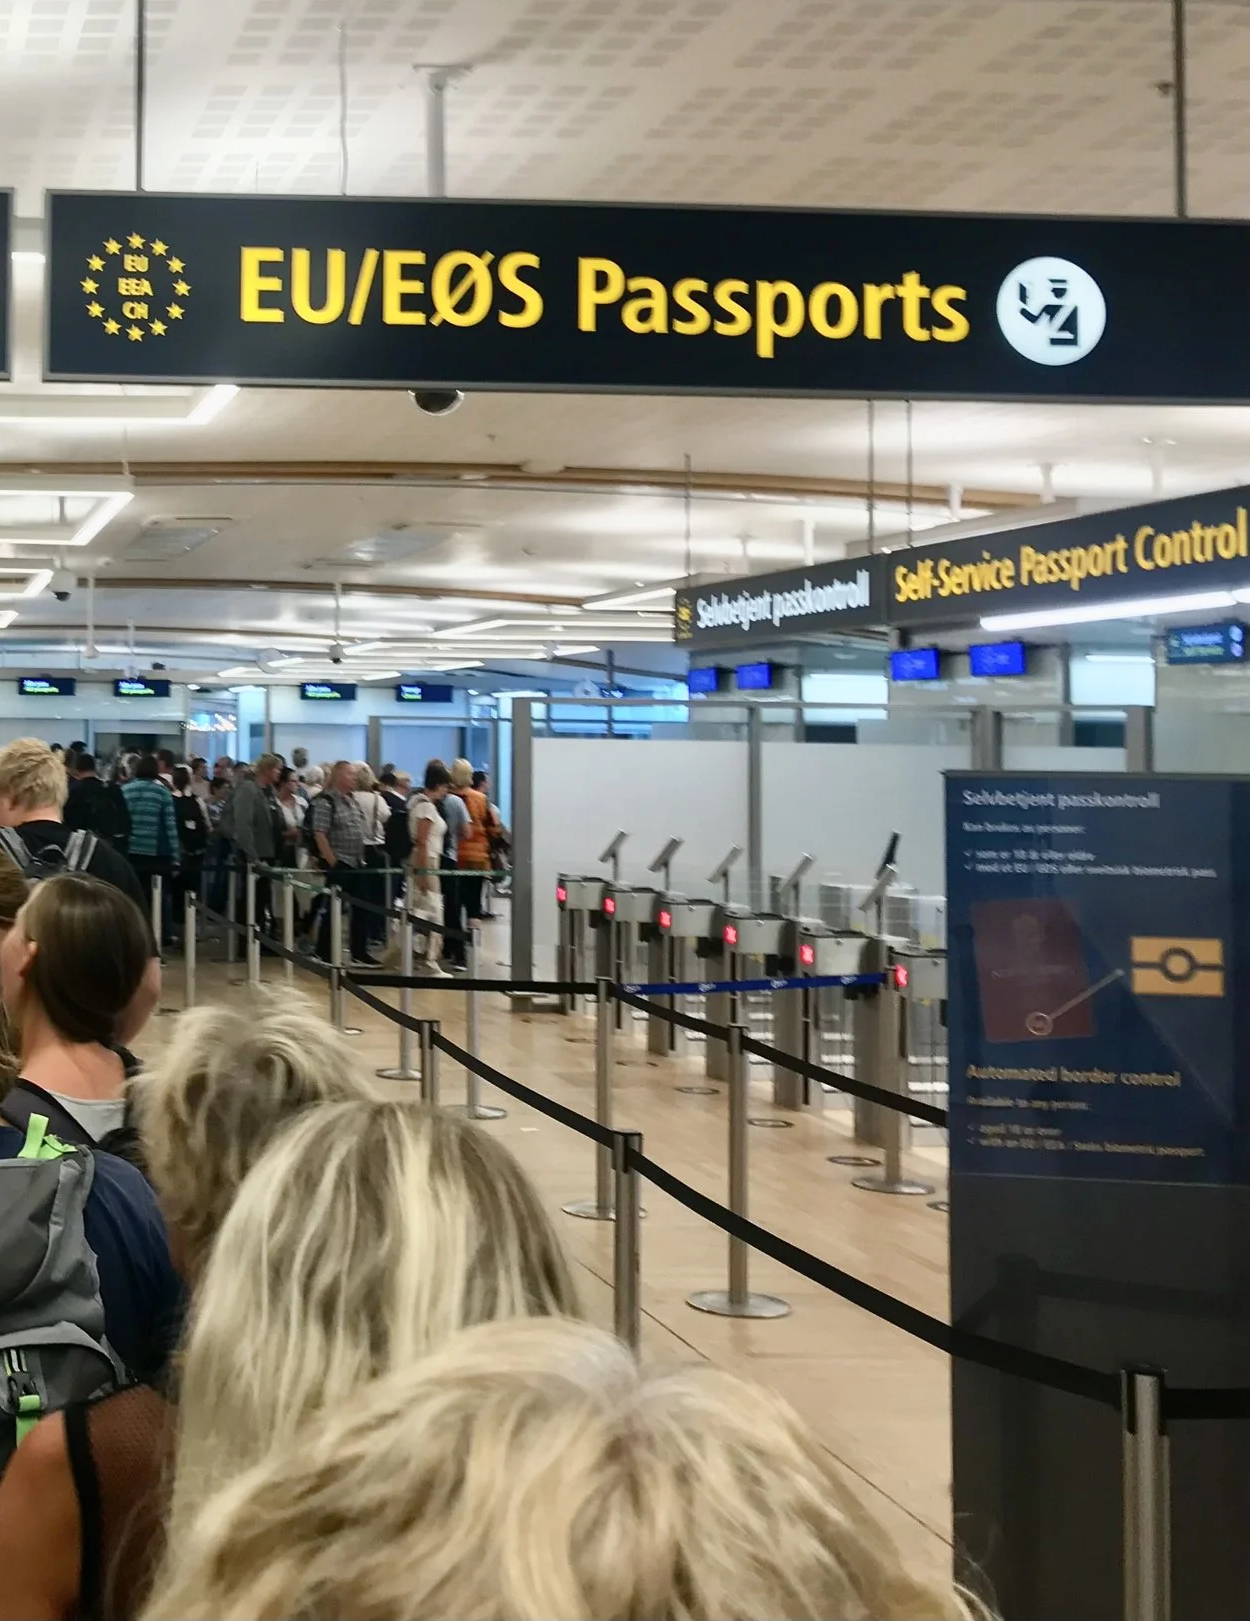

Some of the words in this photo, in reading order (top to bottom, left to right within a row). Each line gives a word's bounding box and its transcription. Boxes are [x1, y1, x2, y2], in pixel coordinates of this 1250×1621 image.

[123, 253, 150, 273] EU
[117, 277, 154, 297] EEA
[121, 301, 149, 320] CH
[238, 245, 544, 330] EU/EØS
[576, 255, 970, 360] Passports
[895, 549, 1016, 602] Self-Service
[1019, 533, 1129, 592] Passport
[1133, 505, 1249, 571] Control
